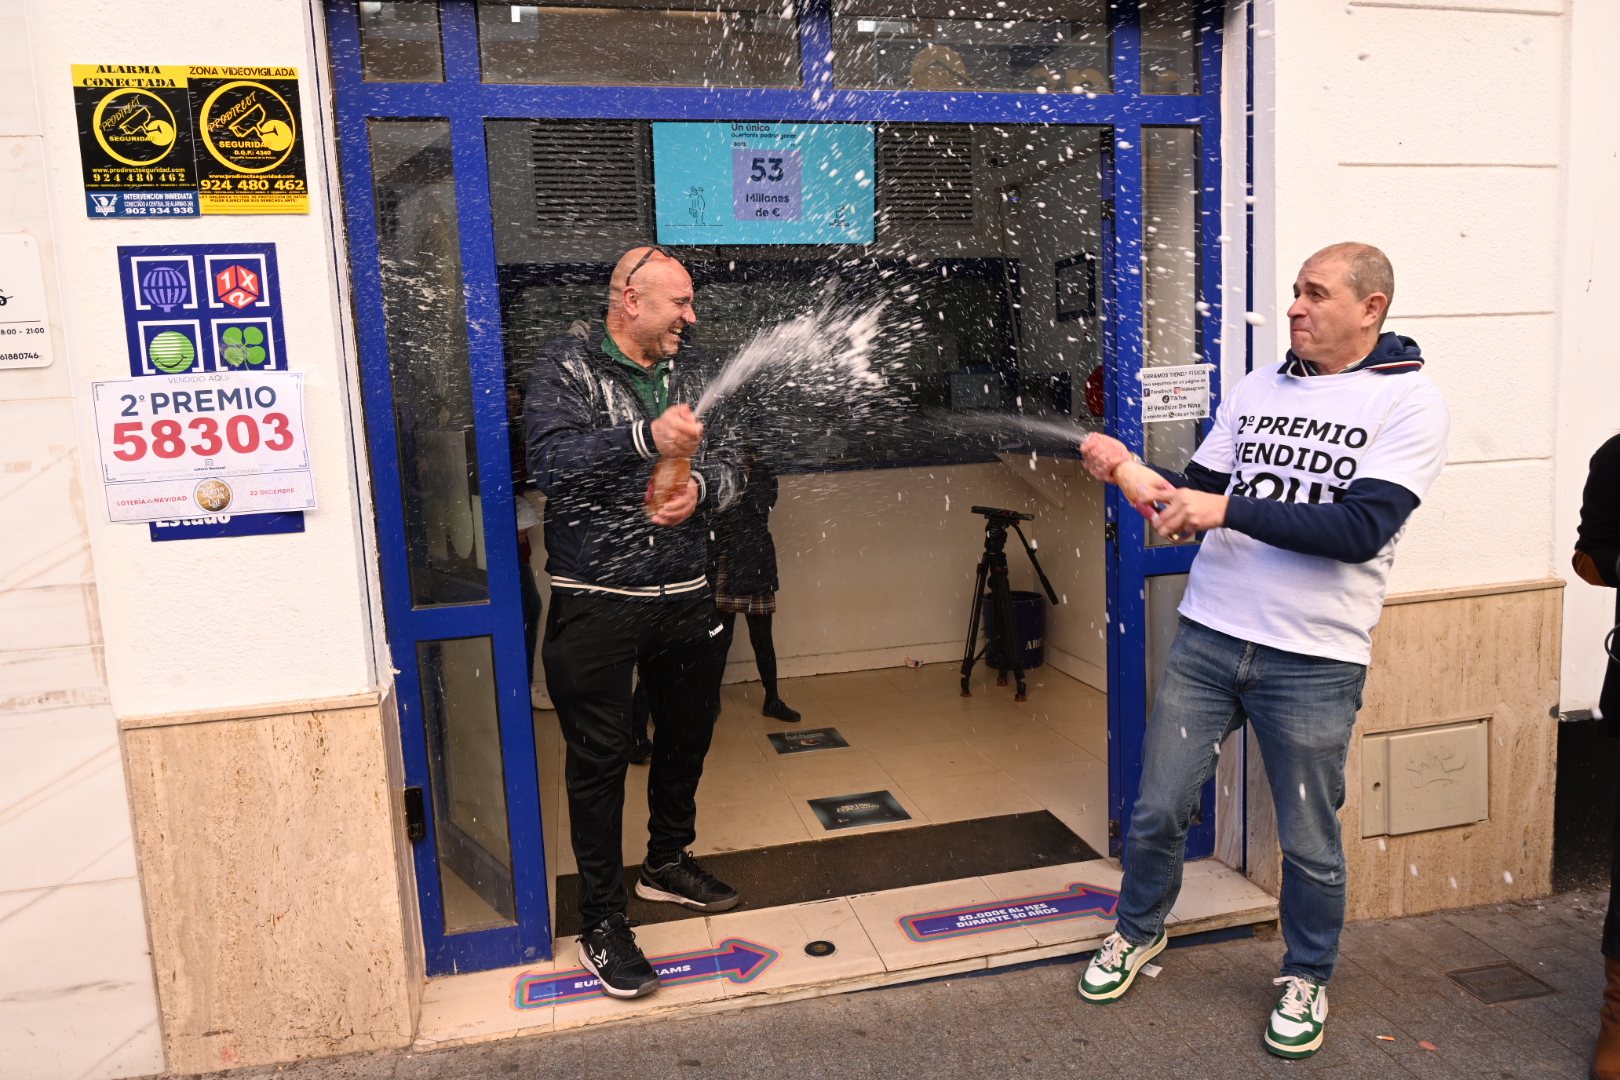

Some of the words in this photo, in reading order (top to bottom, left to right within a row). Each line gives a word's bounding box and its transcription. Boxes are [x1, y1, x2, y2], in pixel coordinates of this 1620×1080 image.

[96, 65, 161, 74] ALARMA
[189, 66, 218, 75] ZONA
[222, 67, 296, 76] VIDEOVIGILADA
[82, 78, 176, 87] CONECTADA
[731, 122, 743, 131] Un
[746, 123, 770, 132] único
[750, 158, 784, 182] 53
[93, 174, 120, 182] 924
[126, 174, 153, 182] 480
[159, 174, 186, 182] 462
[200, 180, 233, 190] 924
[238, 180, 269, 190] 480
[274, 180, 304, 190] 462
[746, 193, 789, 202] Millones
[756, 208, 768, 217] de
[772, 208, 780, 217] €
[209, 374, 230, 382] AQUÍ
[120, 394, 146, 416] 2º
[150, 386, 276, 415] PREMIO
[112, 412, 294, 462] 58303
[1238, 415, 1255, 435] 2º
[1254, 416, 1368, 449] PREMIO
[1235, 442, 1357, 480] VENDIDO
[117, 498, 146, 506] LOTERÍA
[1008, 907, 1024, 915] AL
[1025, 903, 1048, 913] MES
[956, 914, 1011, 928] DURANTE
[1029, 907, 1059, 918] AÑOS
